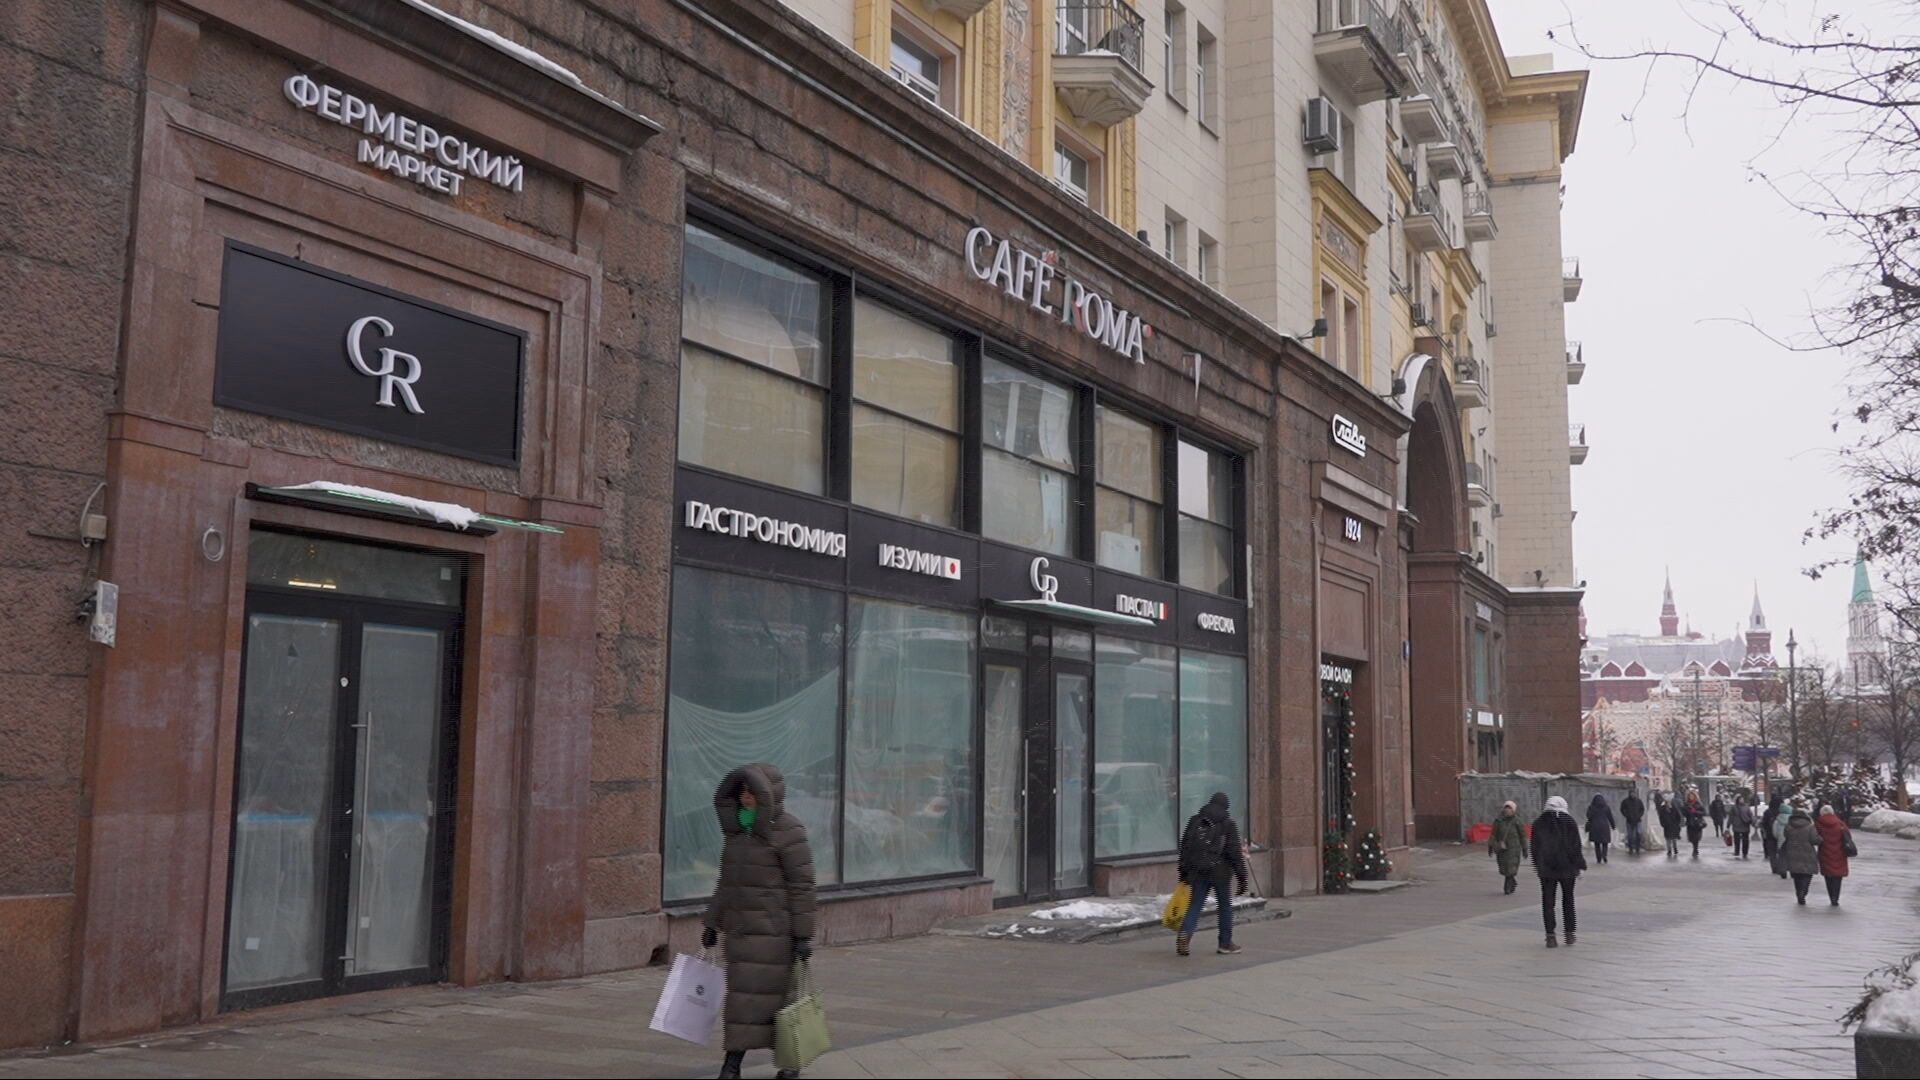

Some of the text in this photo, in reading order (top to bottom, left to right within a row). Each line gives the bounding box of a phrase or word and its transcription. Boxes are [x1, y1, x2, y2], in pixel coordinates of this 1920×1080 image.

[284, 74, 524, 192] ФЕРМЕРСКИЙ
[357, 139, 465, 196] МАРКЕТ
[1061, 276, 1145, 365] ROMA
[685, 500, 847, 558] ГАСТРОНОМИЯ
[1345, 516, 1362, 543] 1924
[879, 543, 942, 576] ИЗУМИ
[1116, 594, 1157, 618] ПАСТА
[1197, 612, 1236, 635] ФРЕСКА
